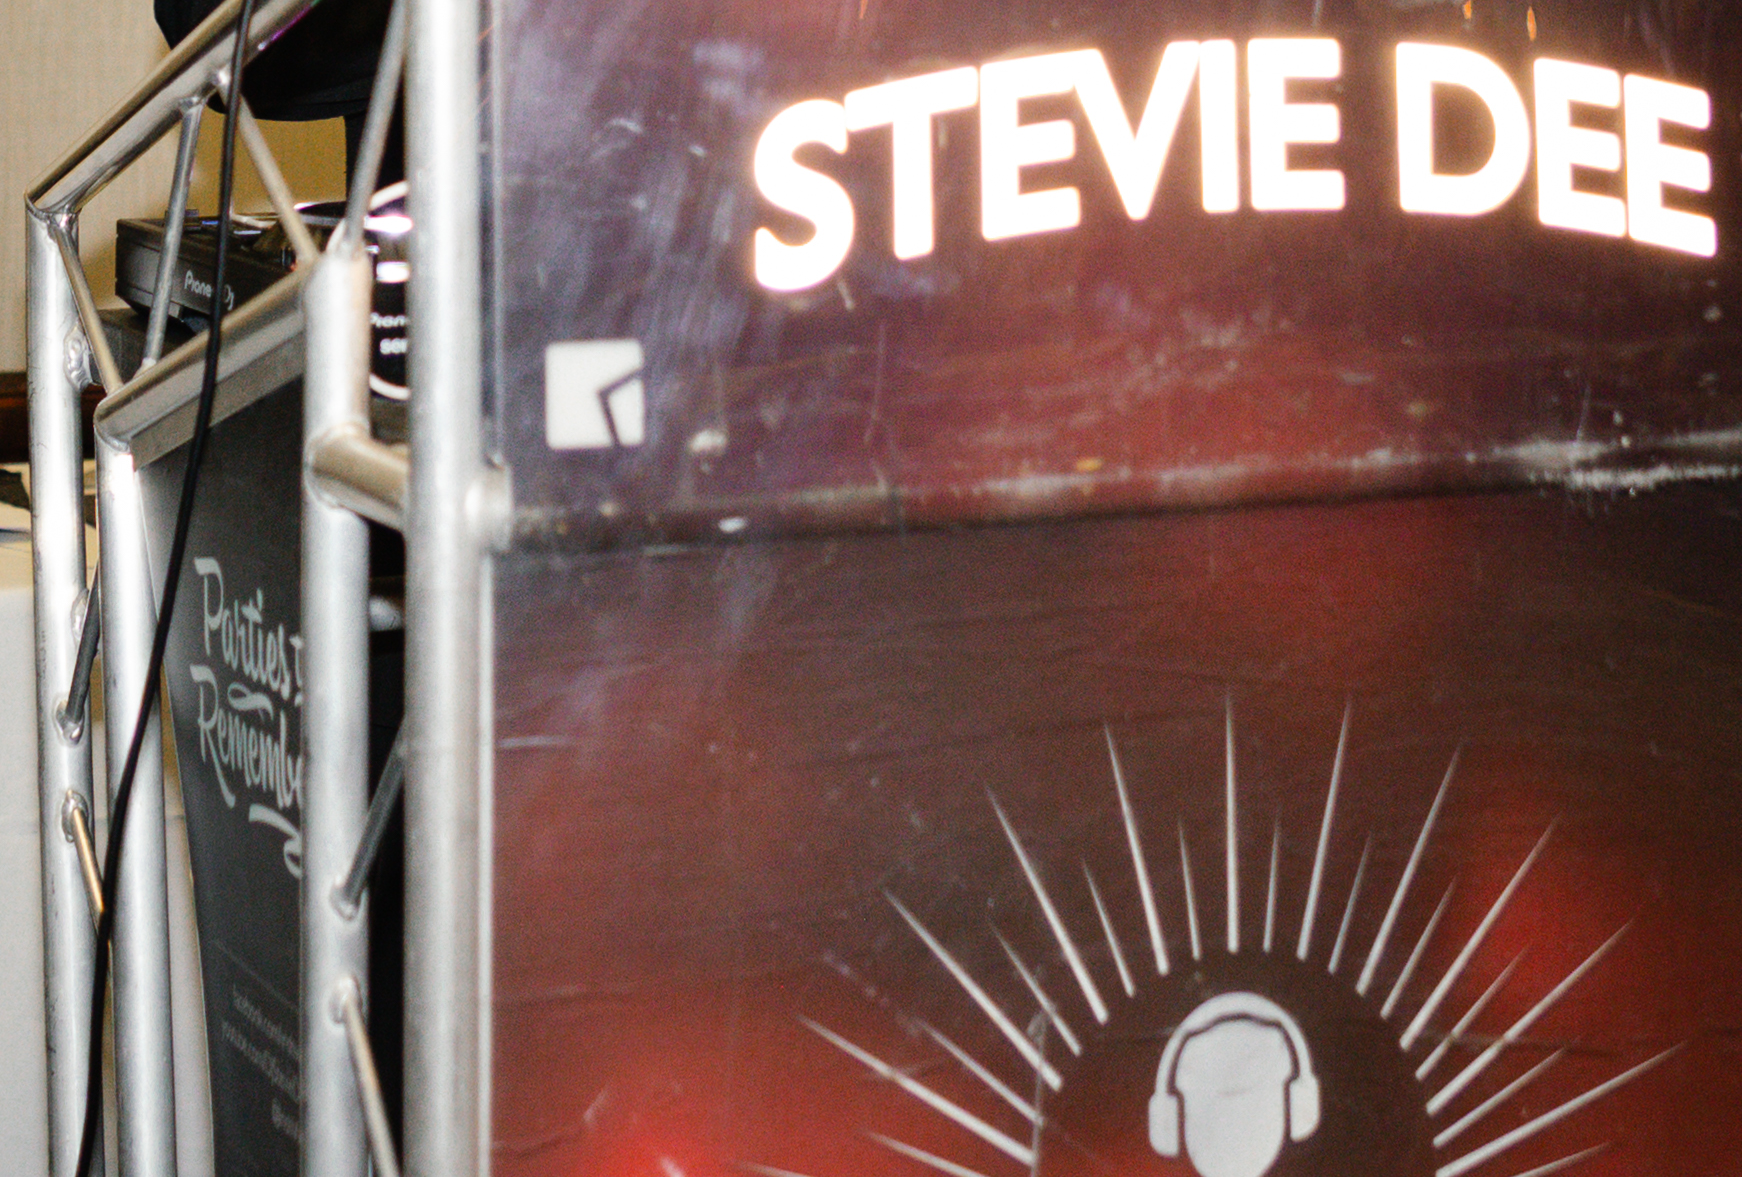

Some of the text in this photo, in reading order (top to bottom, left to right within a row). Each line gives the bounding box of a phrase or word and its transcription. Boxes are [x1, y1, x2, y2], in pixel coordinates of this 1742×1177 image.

[752, 36, 1718, 293] STEVIE DEE
[184, 270, 213, 298] Pione
[194, 557, 291, 701] Parties
[190, 664, 303, 810] Rememb
